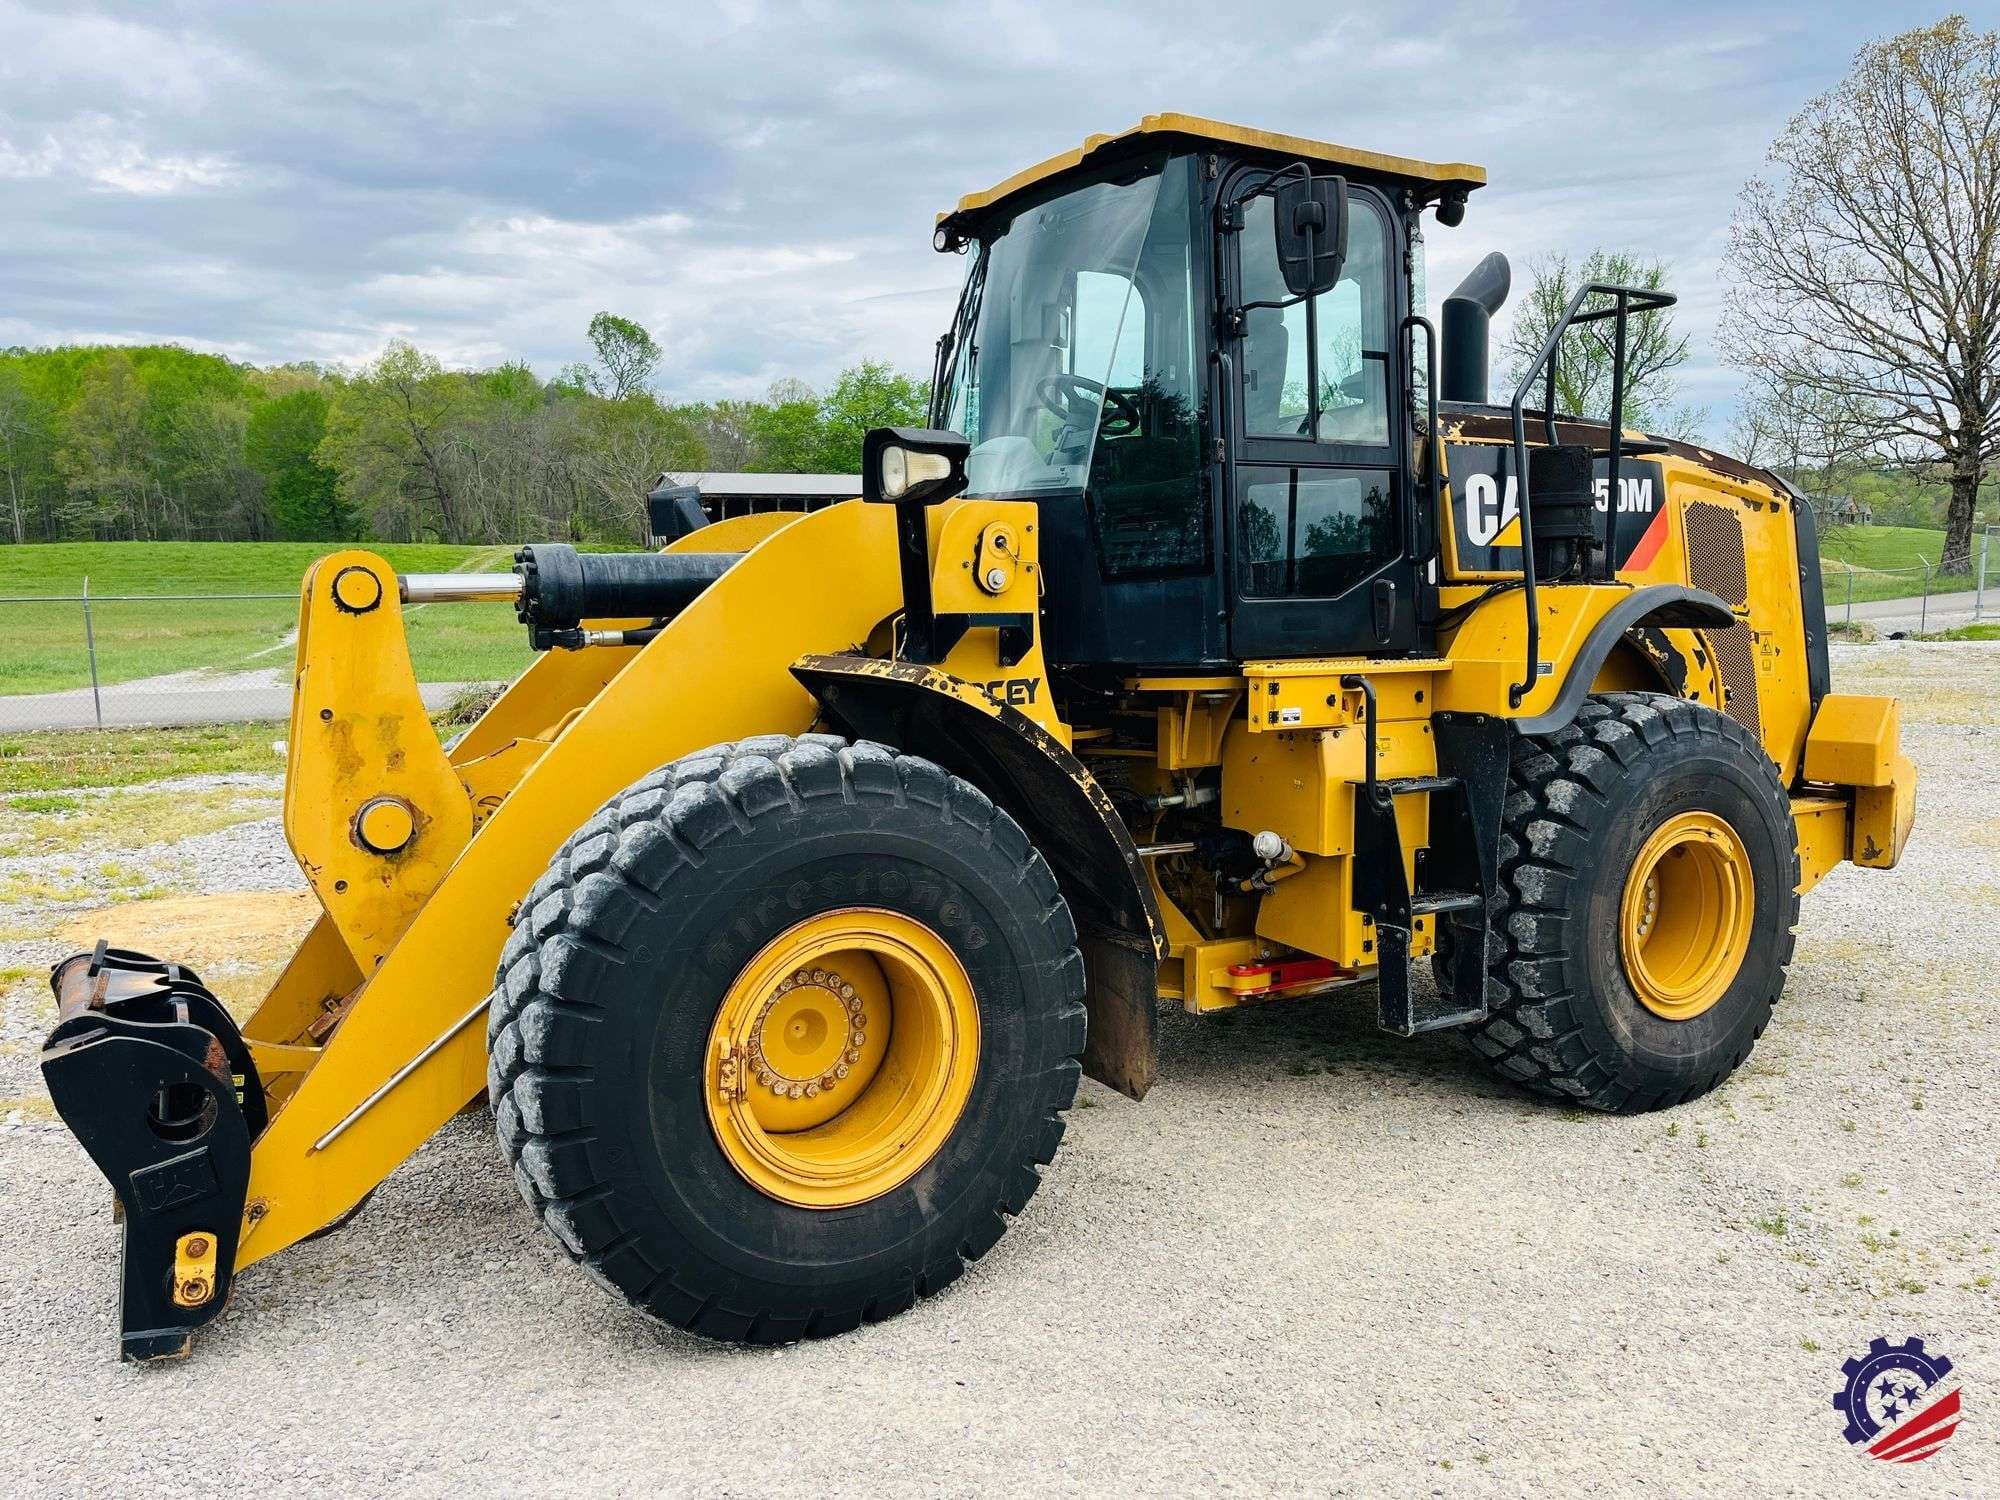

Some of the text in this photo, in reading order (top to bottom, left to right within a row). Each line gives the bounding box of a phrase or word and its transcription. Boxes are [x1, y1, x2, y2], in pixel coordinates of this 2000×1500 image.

[1465, 473, 1652, 547] CA 50M
[973, 677, 1041, 706] CEY
